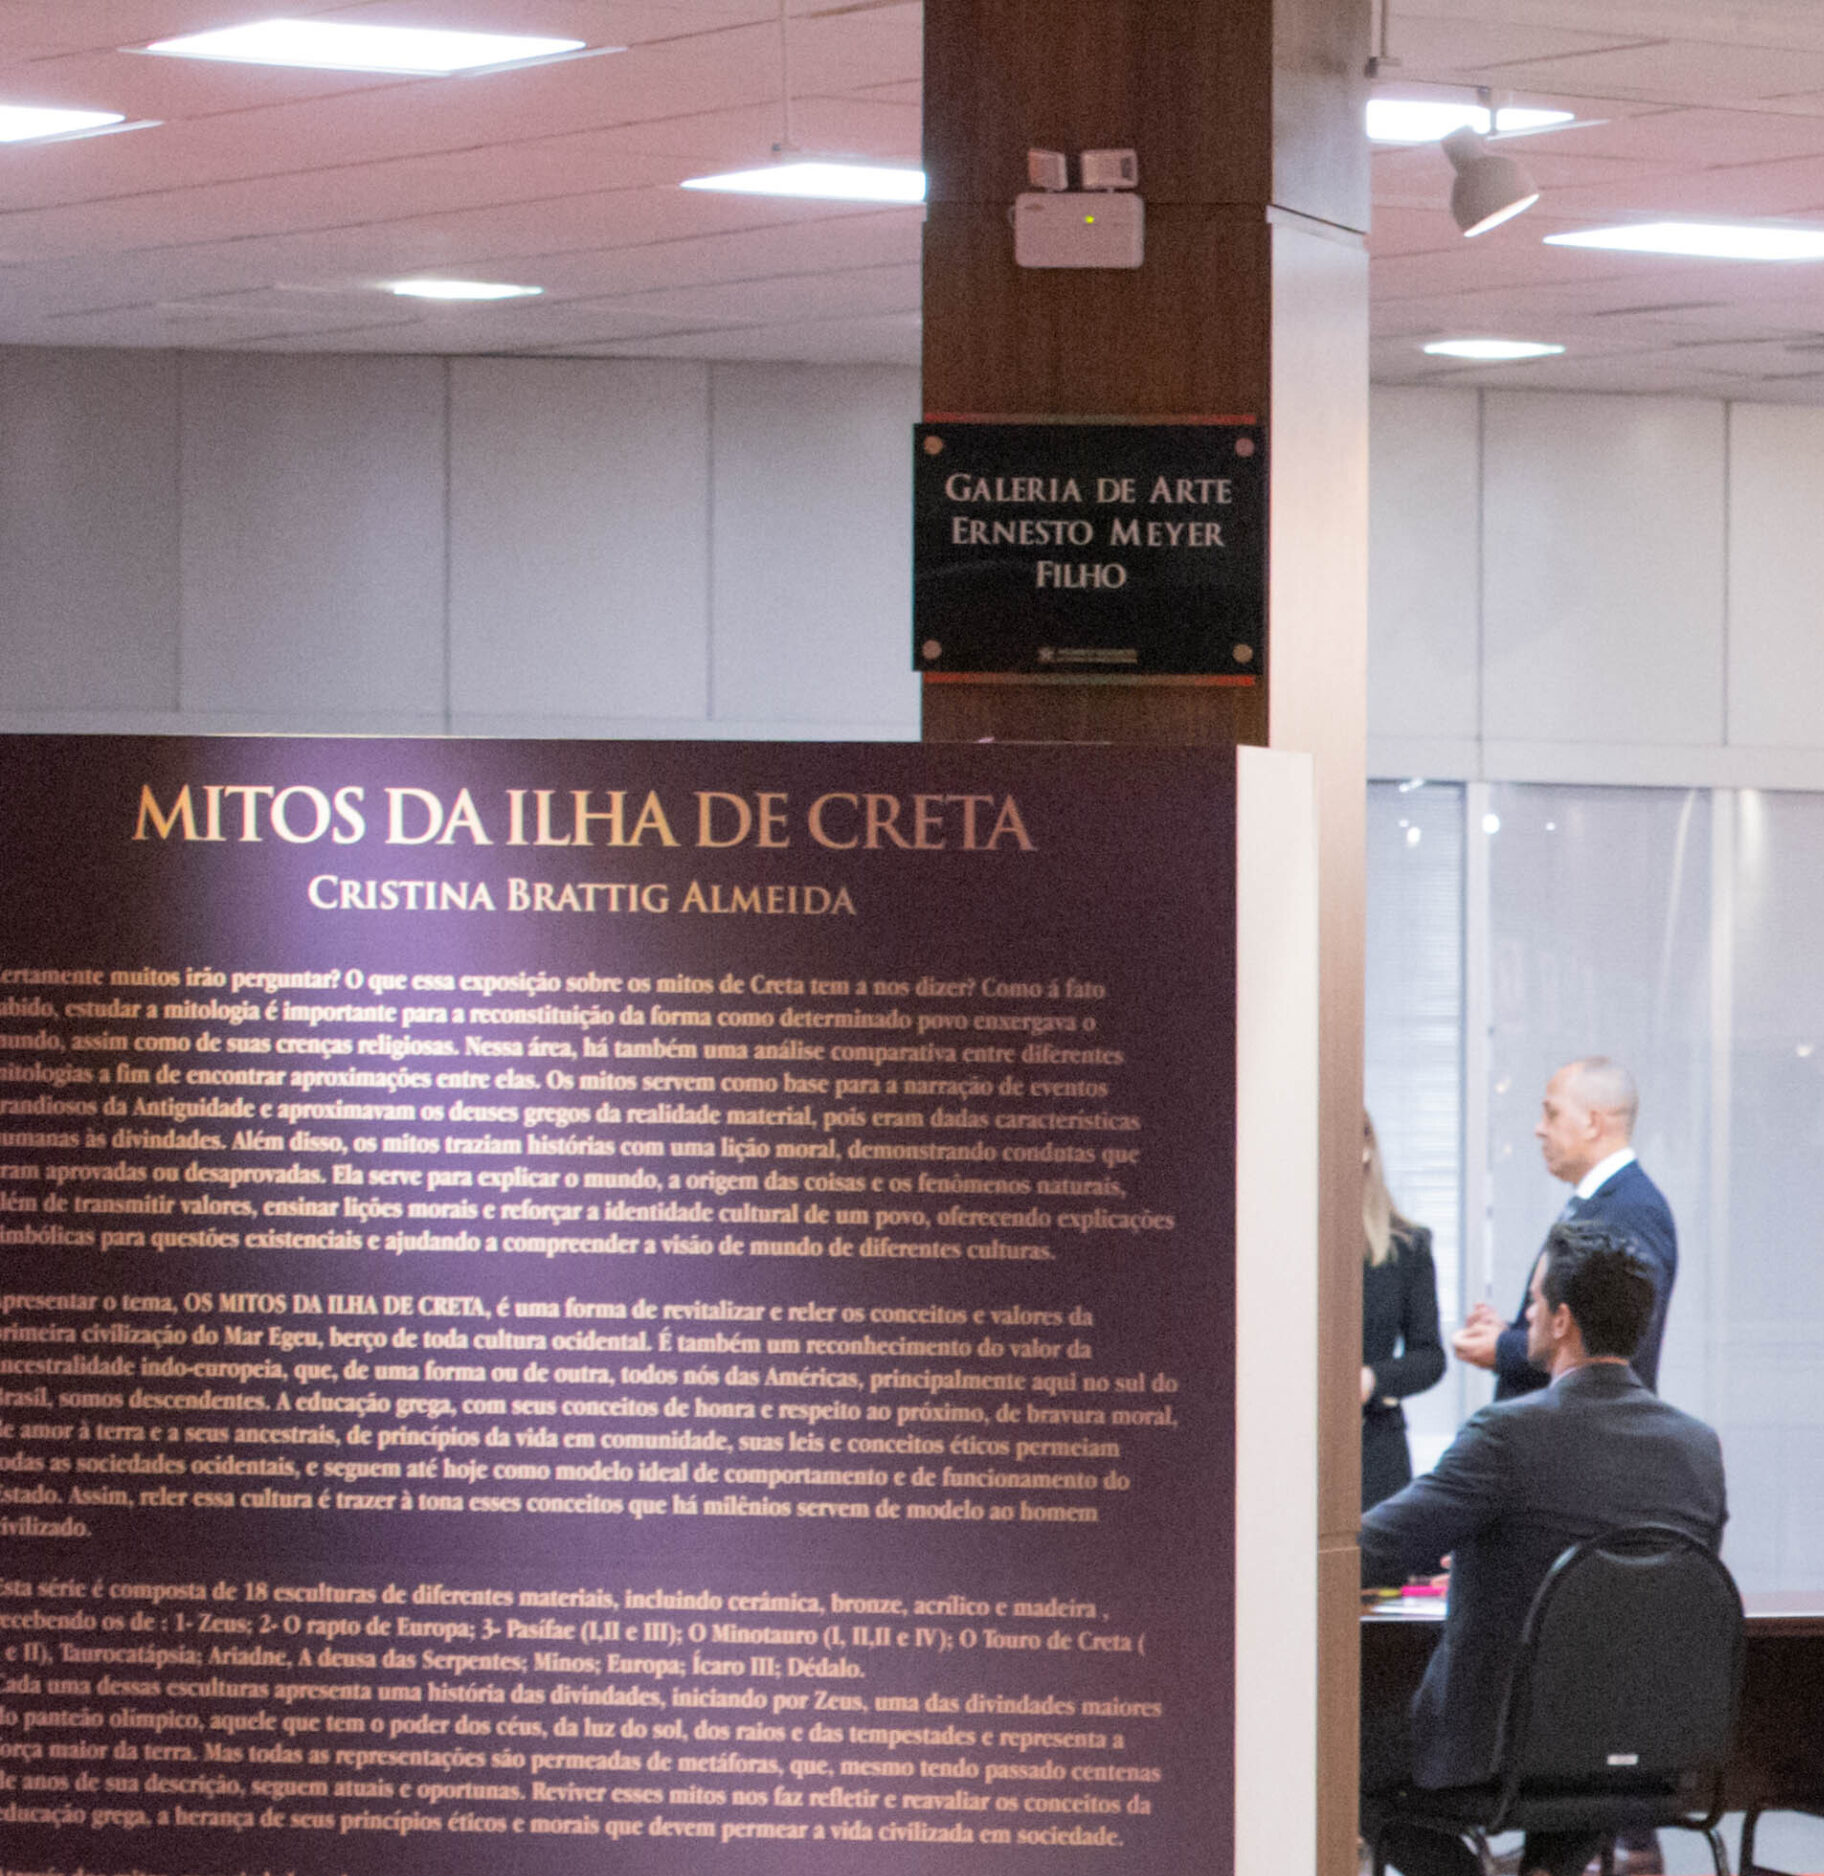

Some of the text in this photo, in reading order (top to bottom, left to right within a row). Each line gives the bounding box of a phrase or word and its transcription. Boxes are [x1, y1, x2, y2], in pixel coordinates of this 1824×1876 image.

[1096, 477, 1137, 504] DE
[131, 783, 1039, 852] MITOS DA ILHA DE CRETA
[0, 967, 103, 984] ertamente
[110, 965, 180, 986] muitos
[185, 965, 227, 986] irão
[231, 967, 341, 993] perguntar?
[344, 968, 364, 989] O
[367, 972, 407, 994] que
[411, 972, 455, 990] essa
[459, 969, 561, 996] exposição
[566, 970, 622, 992] sobre
[627, 975, 651, 993] os
[656, 973, 714, 992] mitos
[719, 972, 744, 994] de
[749, 973, 805, 995] Creta
[810, 978, 850, 995] tem
[856, 978, 868, 994] a
[873, 978, 910, 995] nos
[915, 975, 976, 997] dizer?
[981, 977, 1043, 998] Como
[1065, 976, 1107, 999] fato
[0, 1029, 1126, 1067] undo, assim como de suas crenças religiosas. Nessa área, há também uma análise comparativa entre diferentes
[0, 1132, 80, 1147] umanas
[85, 1132, 106, 1148] às
[111, 1128, 225, 1149] divindades.
[233, 1129, 284, 1150] Além
[289, 1130, 350, 1156] disso,
[353, 1136, 377, 1152] os
[382, 1133, 440, 1153] mitos
[445, 1134, 522, 1154] traziam
[527, 1134, 615, 1155] histórias
[620, 1140, 665, 1156] com
[670, 1141, 715, 1157] uma
[721, 1137, 770, 1164] lição
[775, 1138, 840, 1164] moral,
[847, 1139, 997, 1161] demonstrando
[1101, 1147, 1140, 1170] que
[0, 1291, 1095, 1326] presentar o tema, OS MITOS DA ILHA DE CRETA, é uma forma de revitalizar e reler os conceitos e valores da
[0, 1322, 76, 1342] rimeira
[81, 1322, 187, 1349] civilização
[191, 1324, 219, 1345] do
[225, 1326, 262, 1344] Mar
[329, 1326, 388, 1353] berço
[392, 1327, 417, 1348] de
[423, 1327, 468, 1348] toda
[473, 1328, 547, 1349] cultura
[551, 1329, 651, 1351] ocidental.
[658, 1327, 671, 1350] É
[677, 1331, 761, 1353] também
[766, 1338, 801, 1354] um
[806, 1335, 972, 1356] reconhecimento
[977, 1337, 1005, 1357] do
[1010, 1337, 1061, 1358] valor
[1066, 1338, 1092, 1358] da
[38, 1577, 85, 1598] série
[91, 1578, 103, 1598] é
[109, 1581, 207, 1604] composta
[211, 1579, 237, 1601] de
[245, 1580, 269, 1601] 18
[273, 1580, 377, 1603] esculturas
[381, 1582, 406, 1604] de
[412, 1582, 514, 1606] diferentes
[519, 1586, 620, 1610] materiais,
[625, 1587, 723, 1610] incluindo
[830, 1591, 906, 1616] bronze,
[995, 1598, 1007, 1616] e
[1013, 1596, 1097, 1618] madeira
